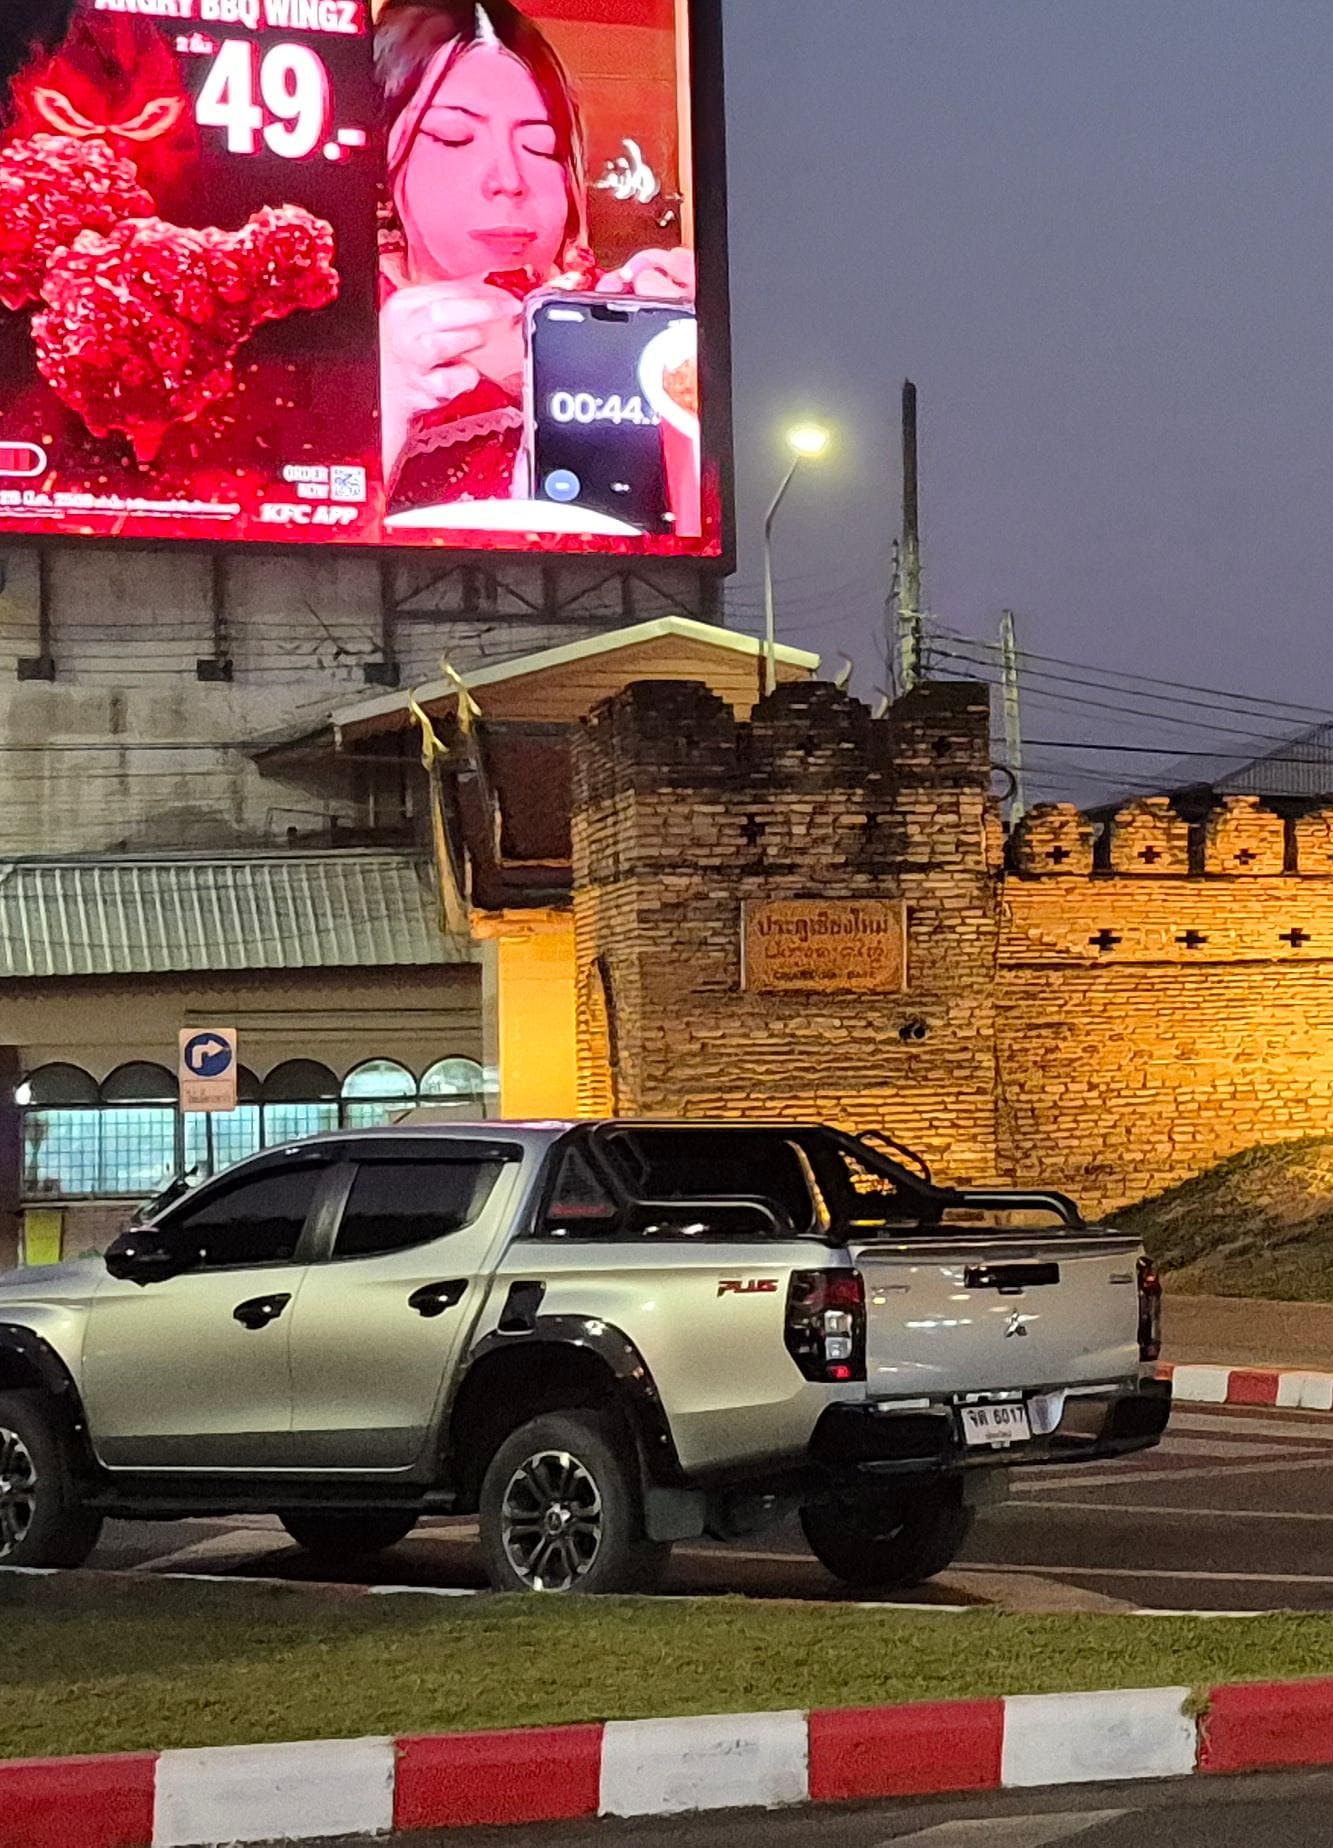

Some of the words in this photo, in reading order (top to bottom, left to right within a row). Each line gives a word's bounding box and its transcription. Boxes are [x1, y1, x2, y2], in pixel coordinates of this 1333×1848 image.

[201, 0, 258, 30] BBQ
[263, 0, 359, 34] WINGZ
[260, 503, 312, 525] KFC
[312, 505, 358, 526] APP
[717, 1279, 779, 1298] PLUS
[993, 1406, 1024, 1425] 6017
